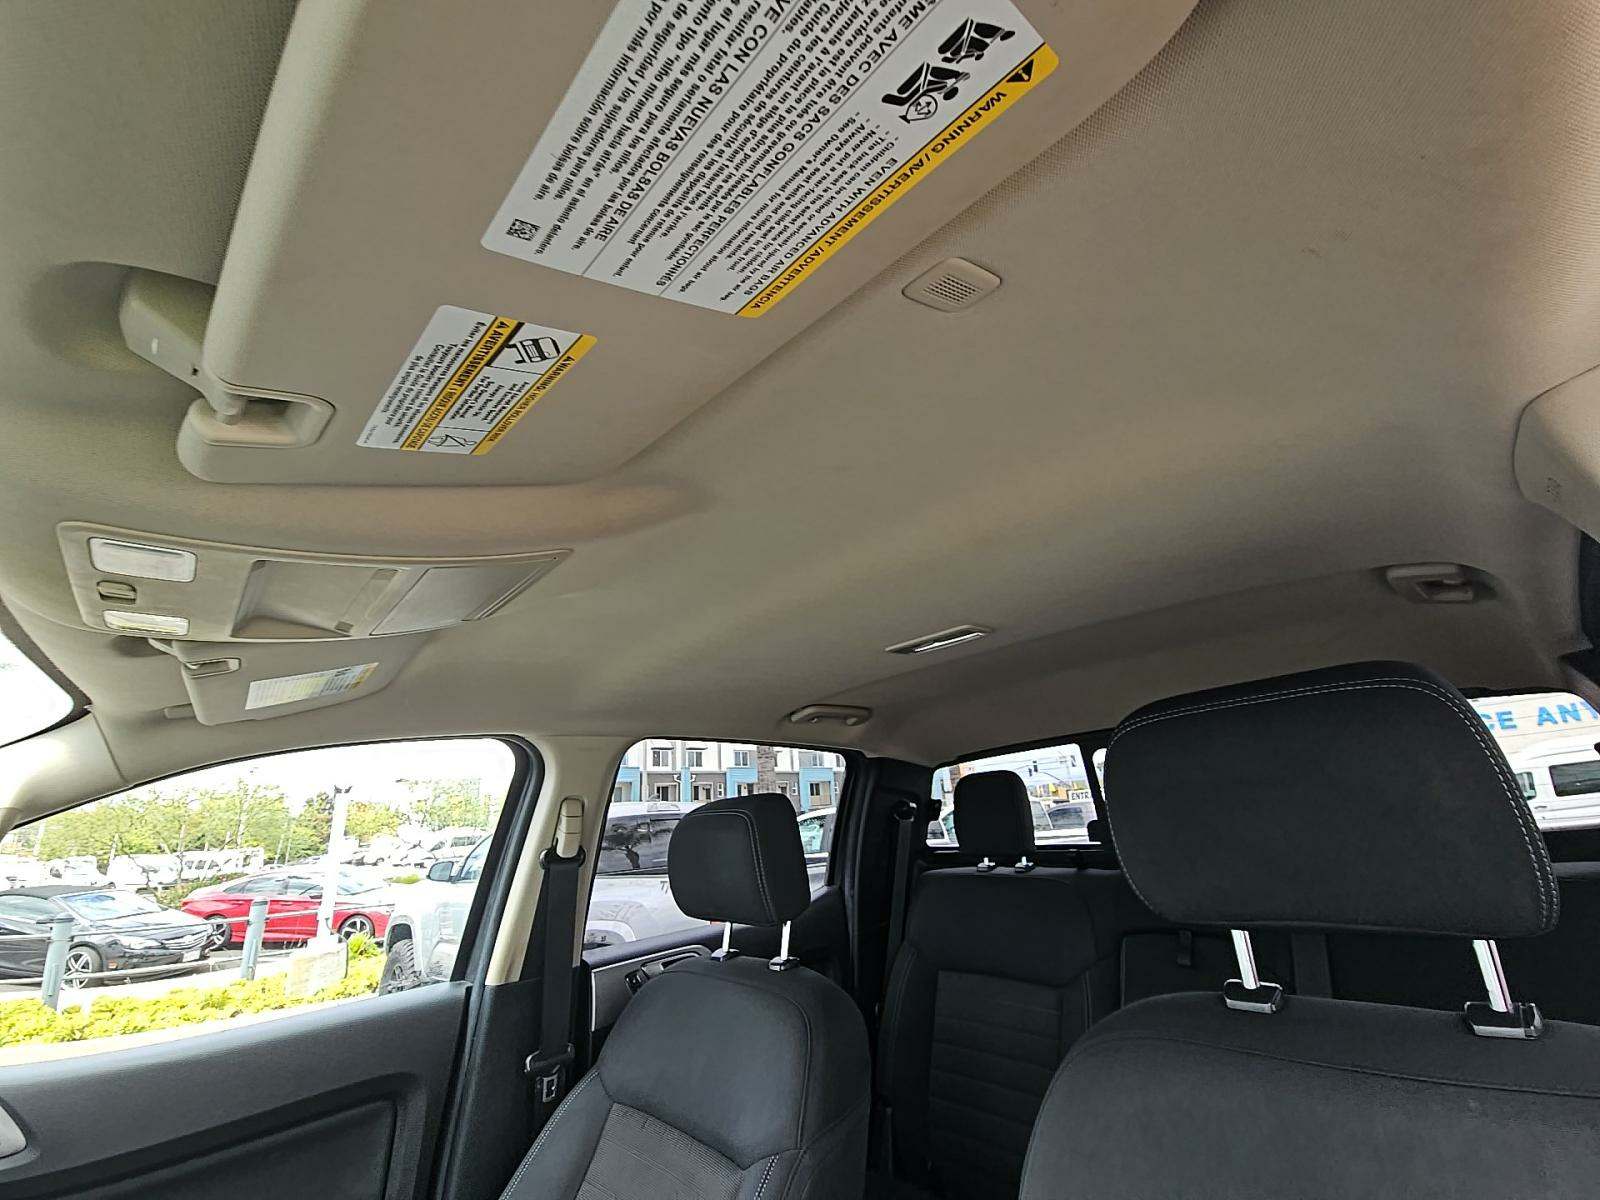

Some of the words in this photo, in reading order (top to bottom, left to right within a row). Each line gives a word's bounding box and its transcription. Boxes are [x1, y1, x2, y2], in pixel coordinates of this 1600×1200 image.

[731, 20, 771, 65] CON
[855, 26, 902, 75] AVEC
[705, 61, 740, 97] LAS
[825, 71, 861, 107] DES
[662, 94, 715, 153] NUEVAS
[790, 103, 832, 143] SACS
[928, 87, 1009, 156] WARNING
[624, 149, 672, 202] BOLSAS
[720, 139, 797, 216] GONFLABLES
[861, 155, 900, 188] EVEN
[611, 199, 634, 218] DE
[832, 184, 867, 213] WITH
[592, 215, 622, 242] AIRE
[781, 210, 840, 260] ADVANCED
[653, 213, 731, 288] PERFECTIONNÉS
[765, 258, 788, 275] AIR
[741, 273, 772, 296] BAGS
[1071, 791, 1091, 800] ENTR
